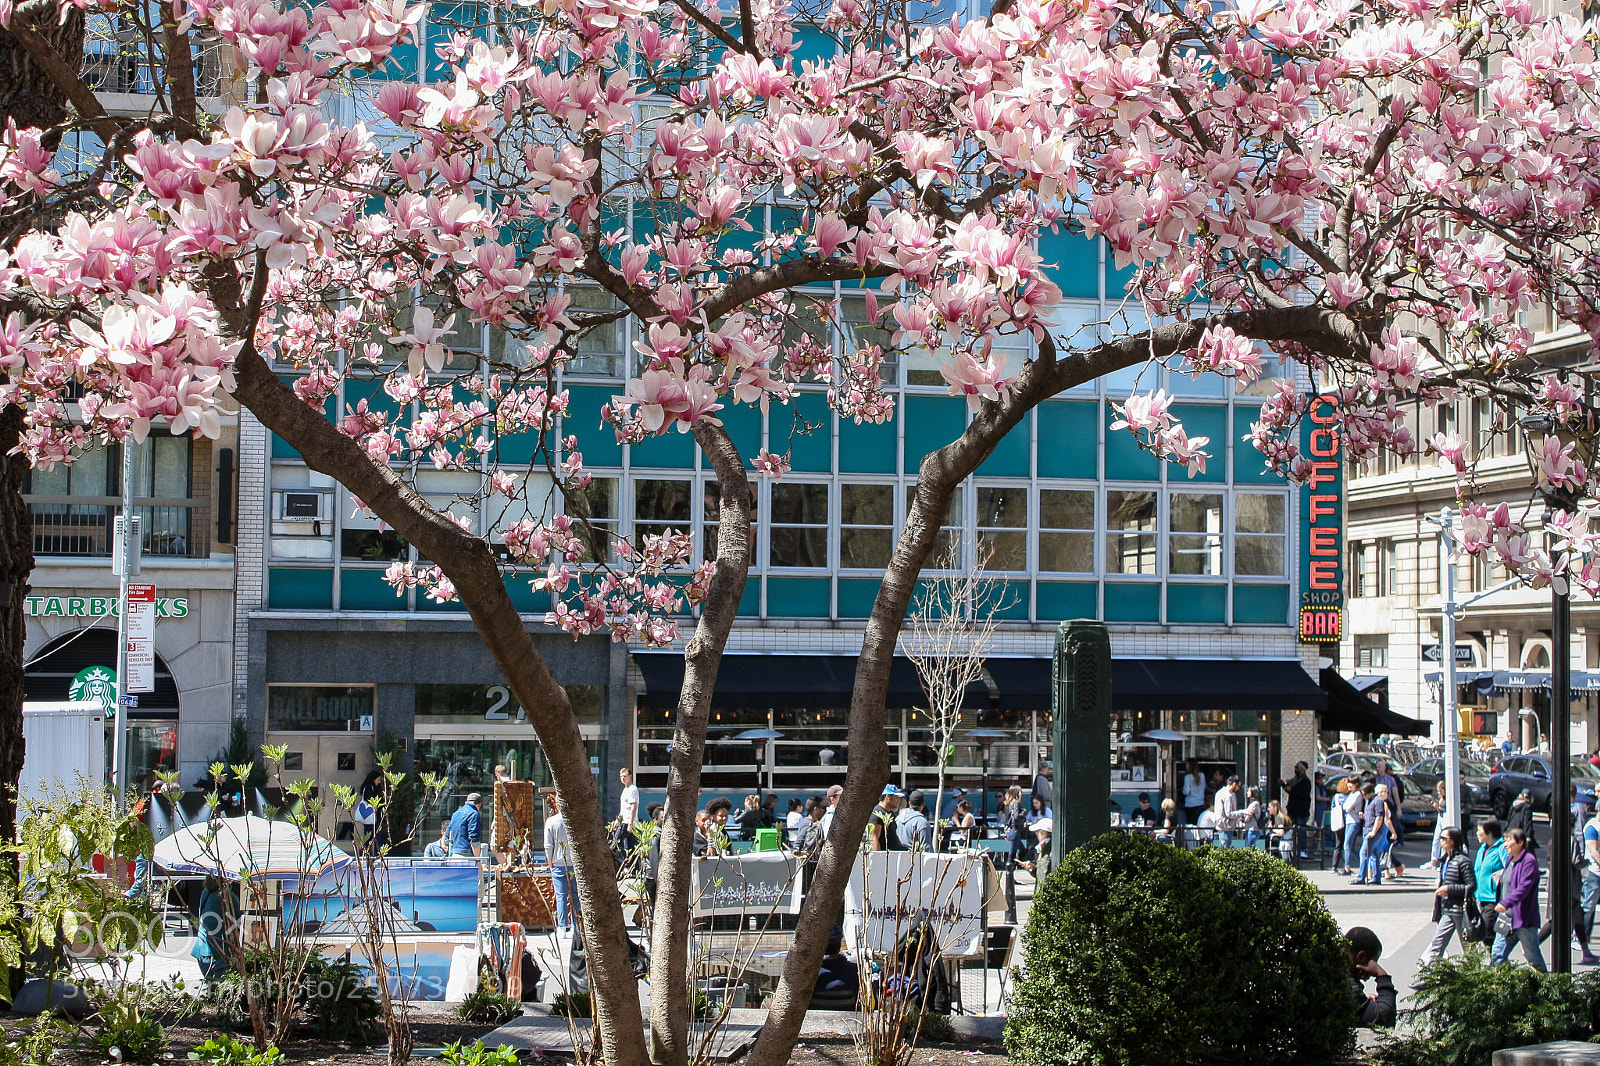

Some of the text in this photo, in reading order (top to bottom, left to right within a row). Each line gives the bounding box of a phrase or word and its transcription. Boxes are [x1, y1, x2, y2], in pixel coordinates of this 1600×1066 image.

[1309, 395, 1340, 590] COFFEE
[1302, 592, 1340, 604] SHOP
[26, 597, 188, 618] TARBUKS
[1303, 612, 1339, 636] BAR
[130, 642, 134, 651] 3
[272, 696, 371, 721] BALLROOM
[362, 718, 371, 727] A
[1135, 768, 1142, 776] A
